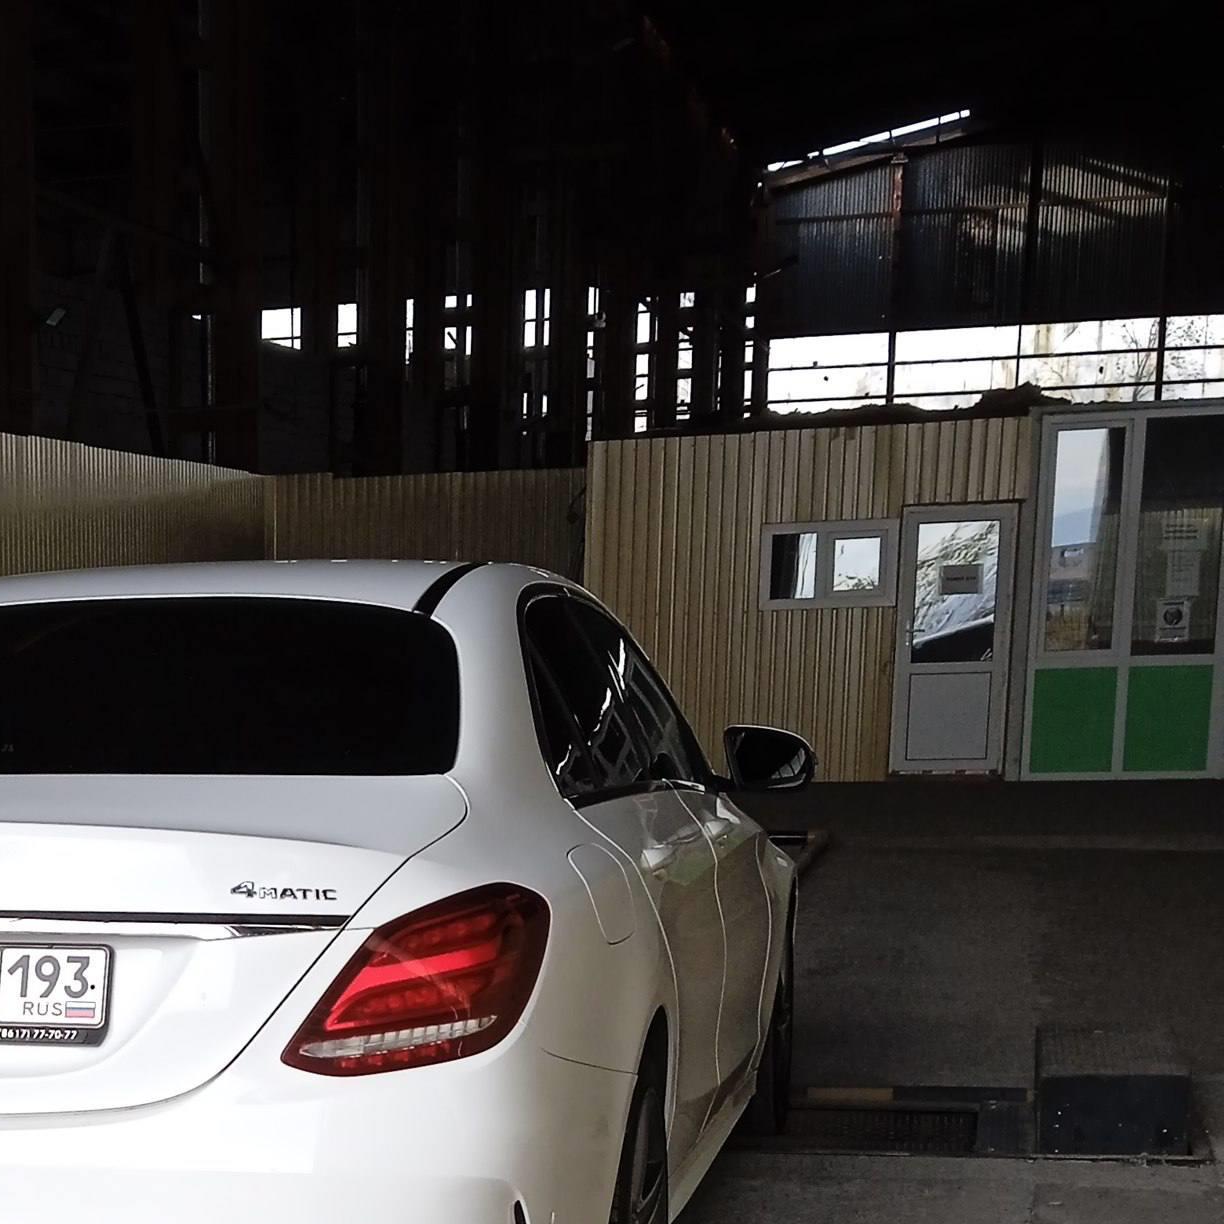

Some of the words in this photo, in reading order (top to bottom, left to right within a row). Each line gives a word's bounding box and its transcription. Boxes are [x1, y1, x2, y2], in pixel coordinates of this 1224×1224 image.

[230, 881, 338, 901] 4MATIC
[7, 954, 91, 999] 193
[22, 1001, 63, 1017] RUS
